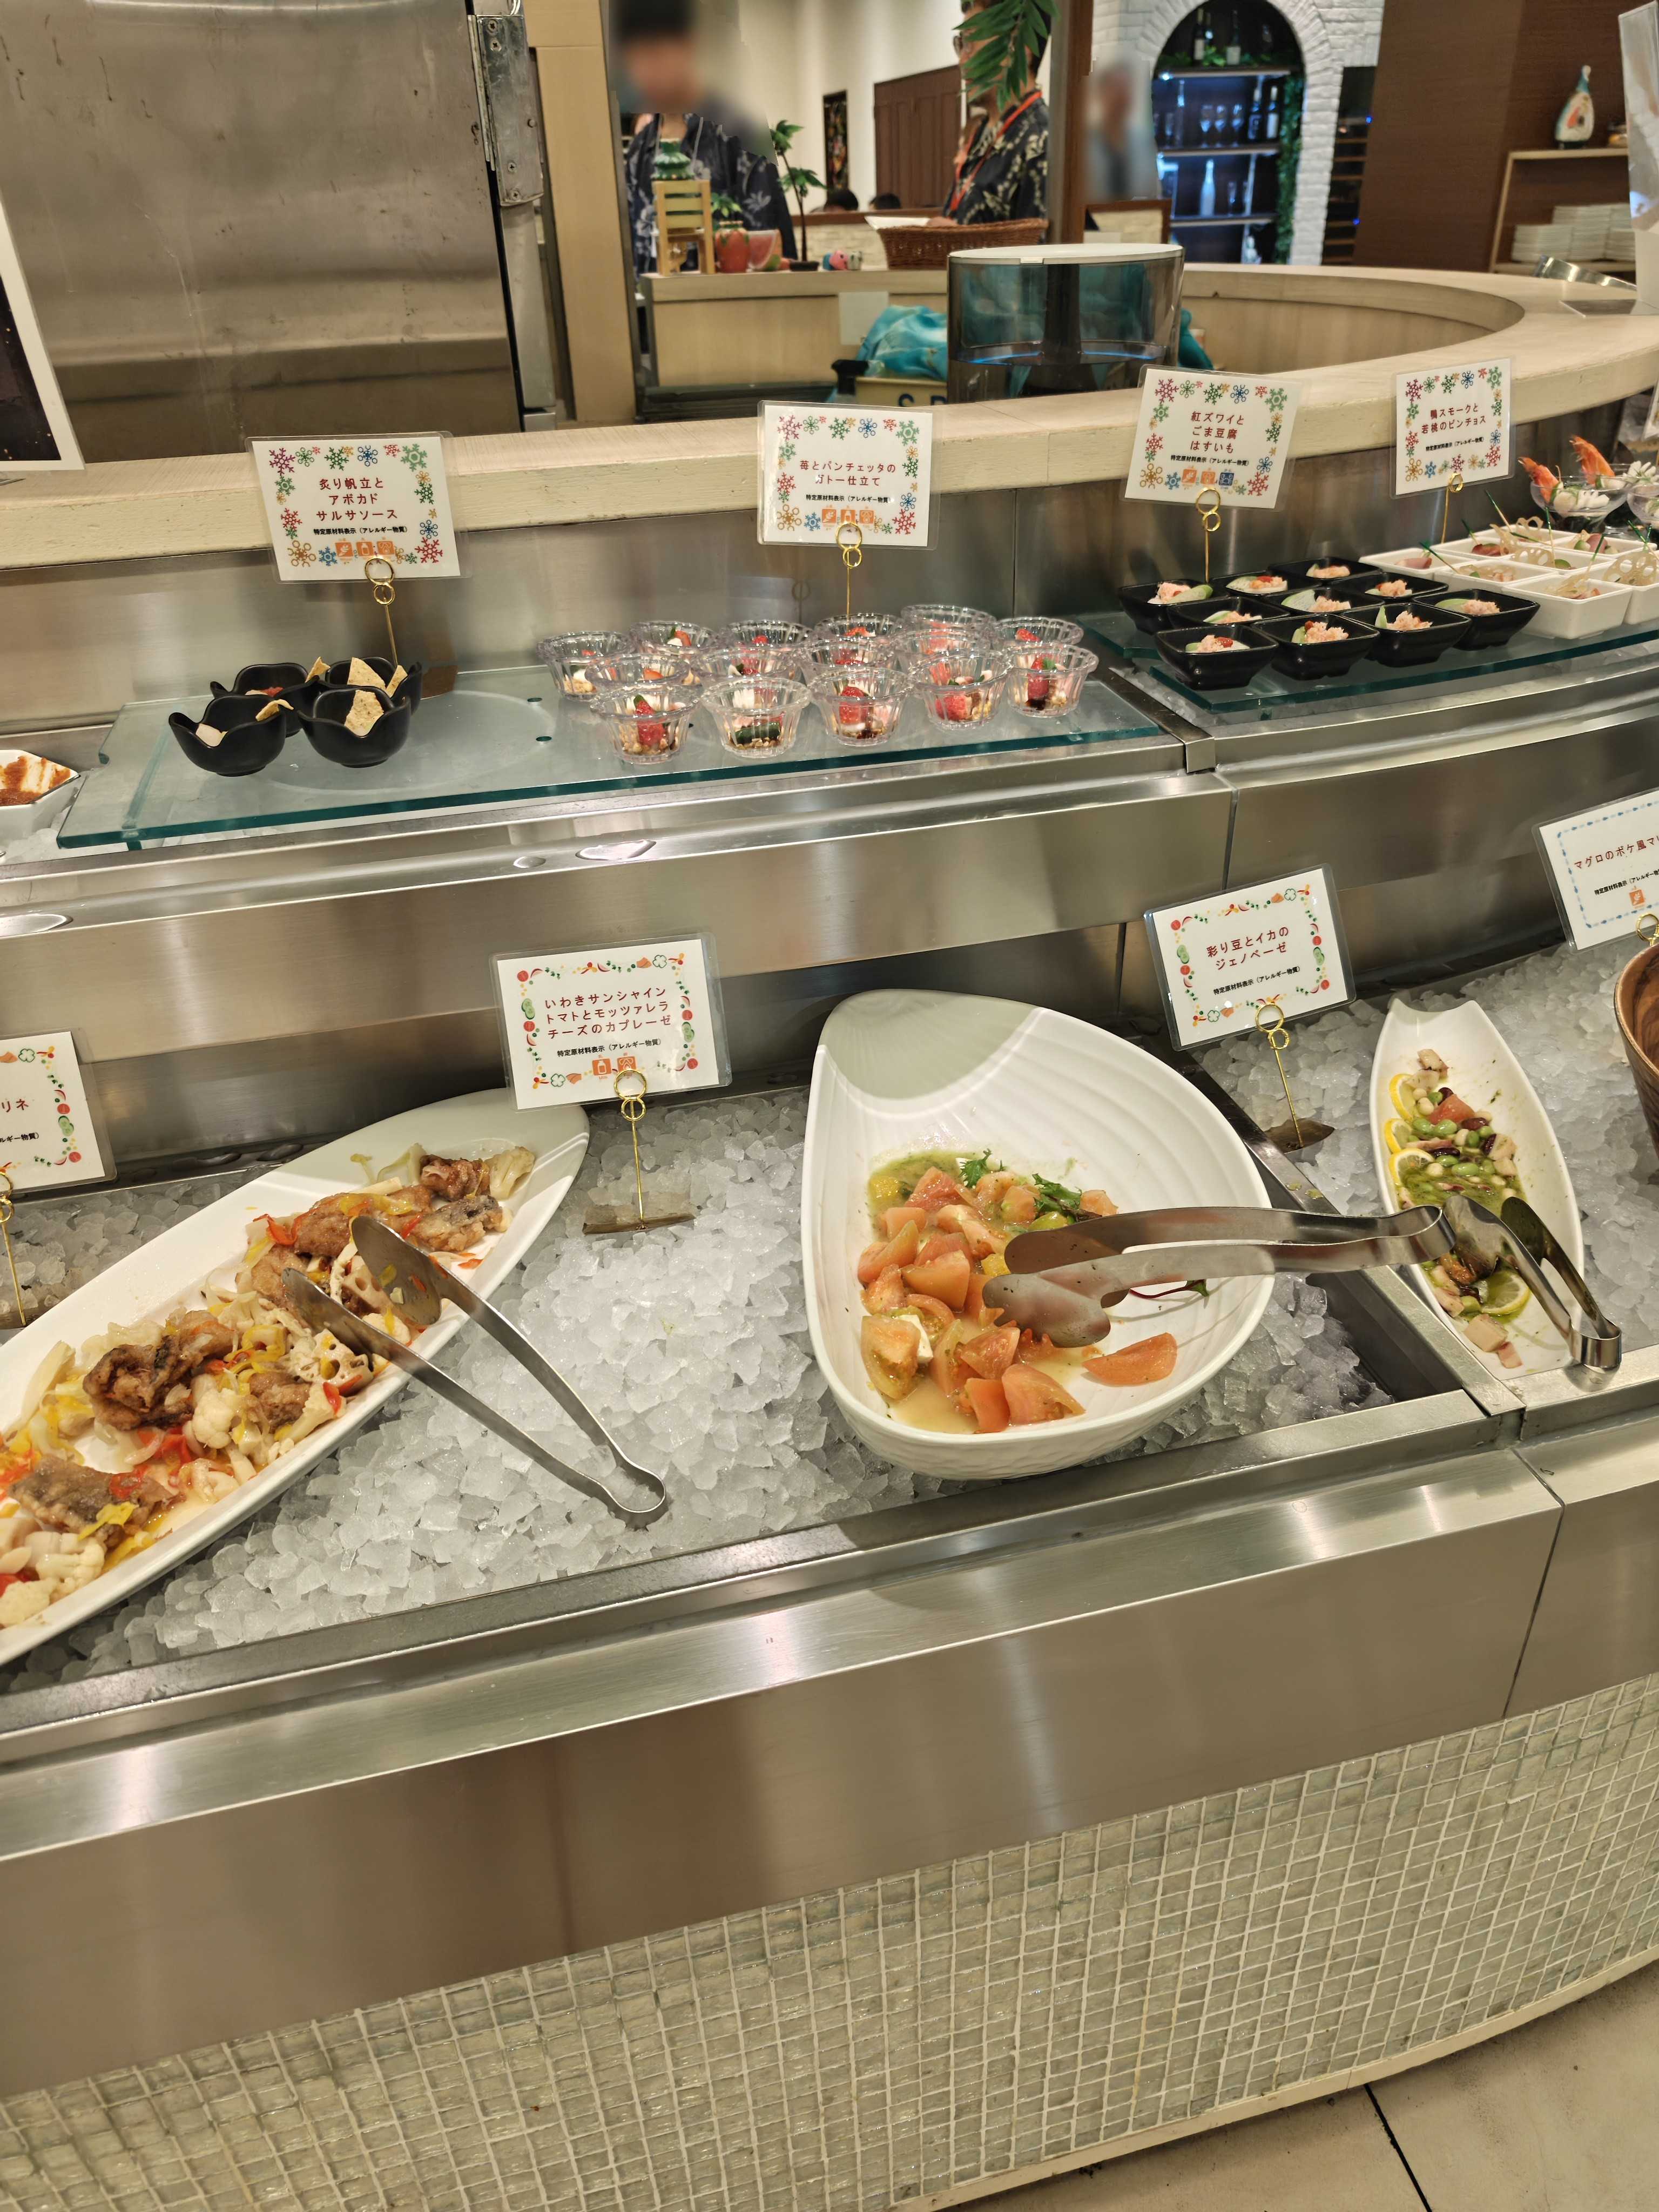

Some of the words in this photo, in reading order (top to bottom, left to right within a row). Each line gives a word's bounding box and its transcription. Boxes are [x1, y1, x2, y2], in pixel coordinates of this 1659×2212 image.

[1191, 411, 1244, 425] 紅ズワイと
[1192, 426, 1238, 439] ごま豆腐
[1190, 441, 1233, 454] はすいも
[800, 460, 895, 473] 苺とパンチェッタの
[319, 477, 384, 490] 炙り帆立と
[329, 493, 379, 505] アボカド
[316, 509, 398, 521] サルサソース
[1206, 927, 1289, 957] 彩り豆とイカの
[1216, 942, 1287, 970] ジェノベーゼ
[545, 987, 666, 1009] いわきサンシャイン
[547, 1001, 669, 1024] トマトとモッツァレラ
[548, 1015, 671, 1038] チーズのカプレーゼ
